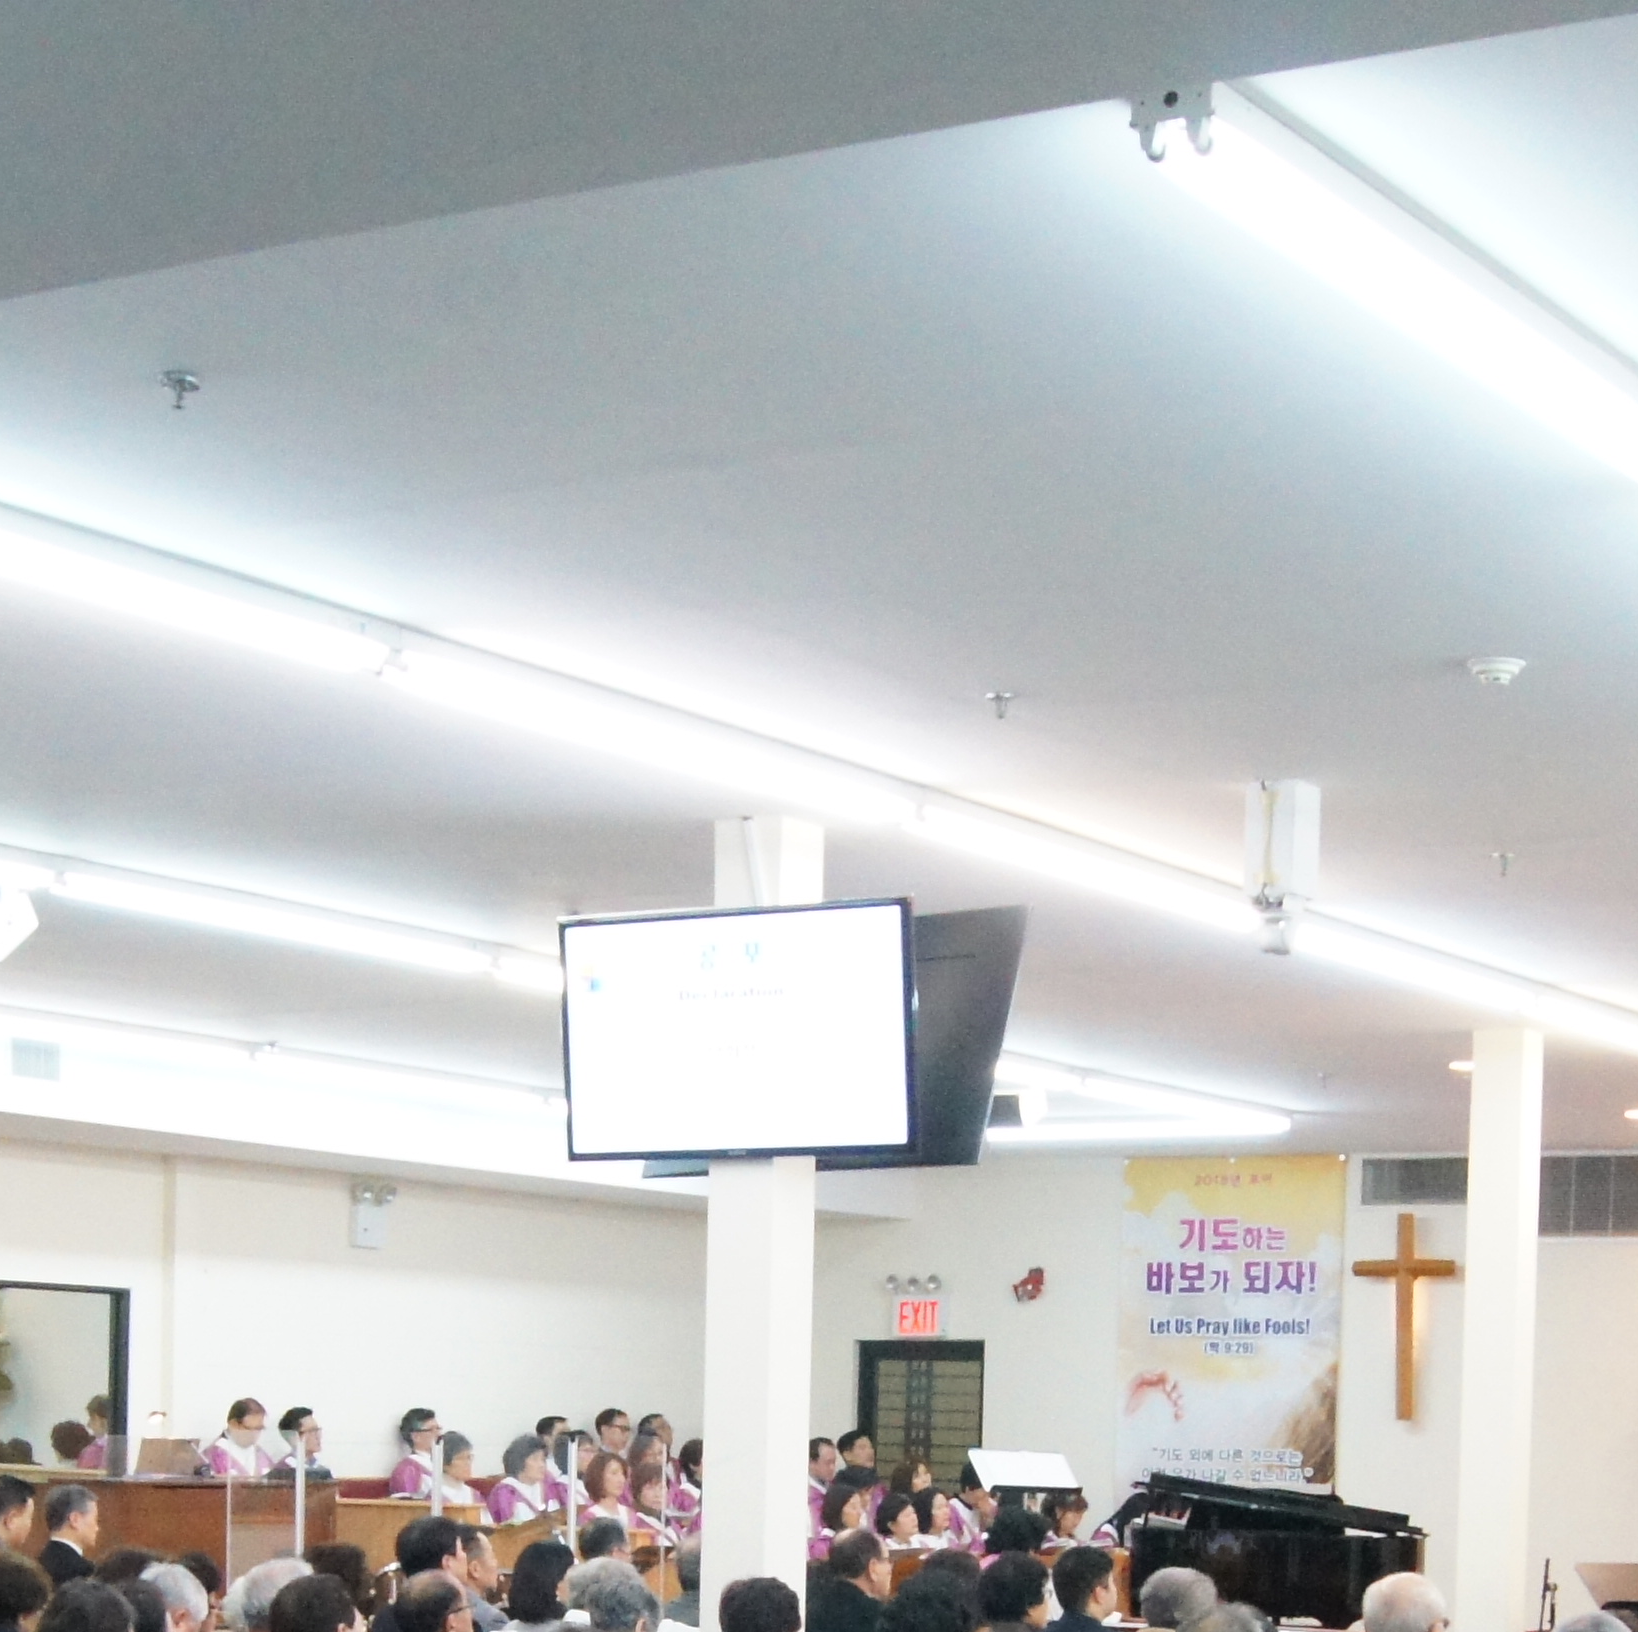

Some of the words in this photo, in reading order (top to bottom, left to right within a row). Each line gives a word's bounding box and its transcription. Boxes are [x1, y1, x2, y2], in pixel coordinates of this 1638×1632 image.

[1178, 1218, 1286, 1252] 기도하는
[1146, 1261, 1230, 1294] 바보가
[1243, 1261, 1317, 1295] 되자!
[899, 1300, 939, 1334] EXIT
[1150, 1317, 1171, 1334] Let
[1175, 1317, 1192, 1334] Us
[1197, 1317, 1229, 1336] Pray
[1233, 1317, 1260, 1334] like
[1265, 1317, 1310, 1335] Fools!
